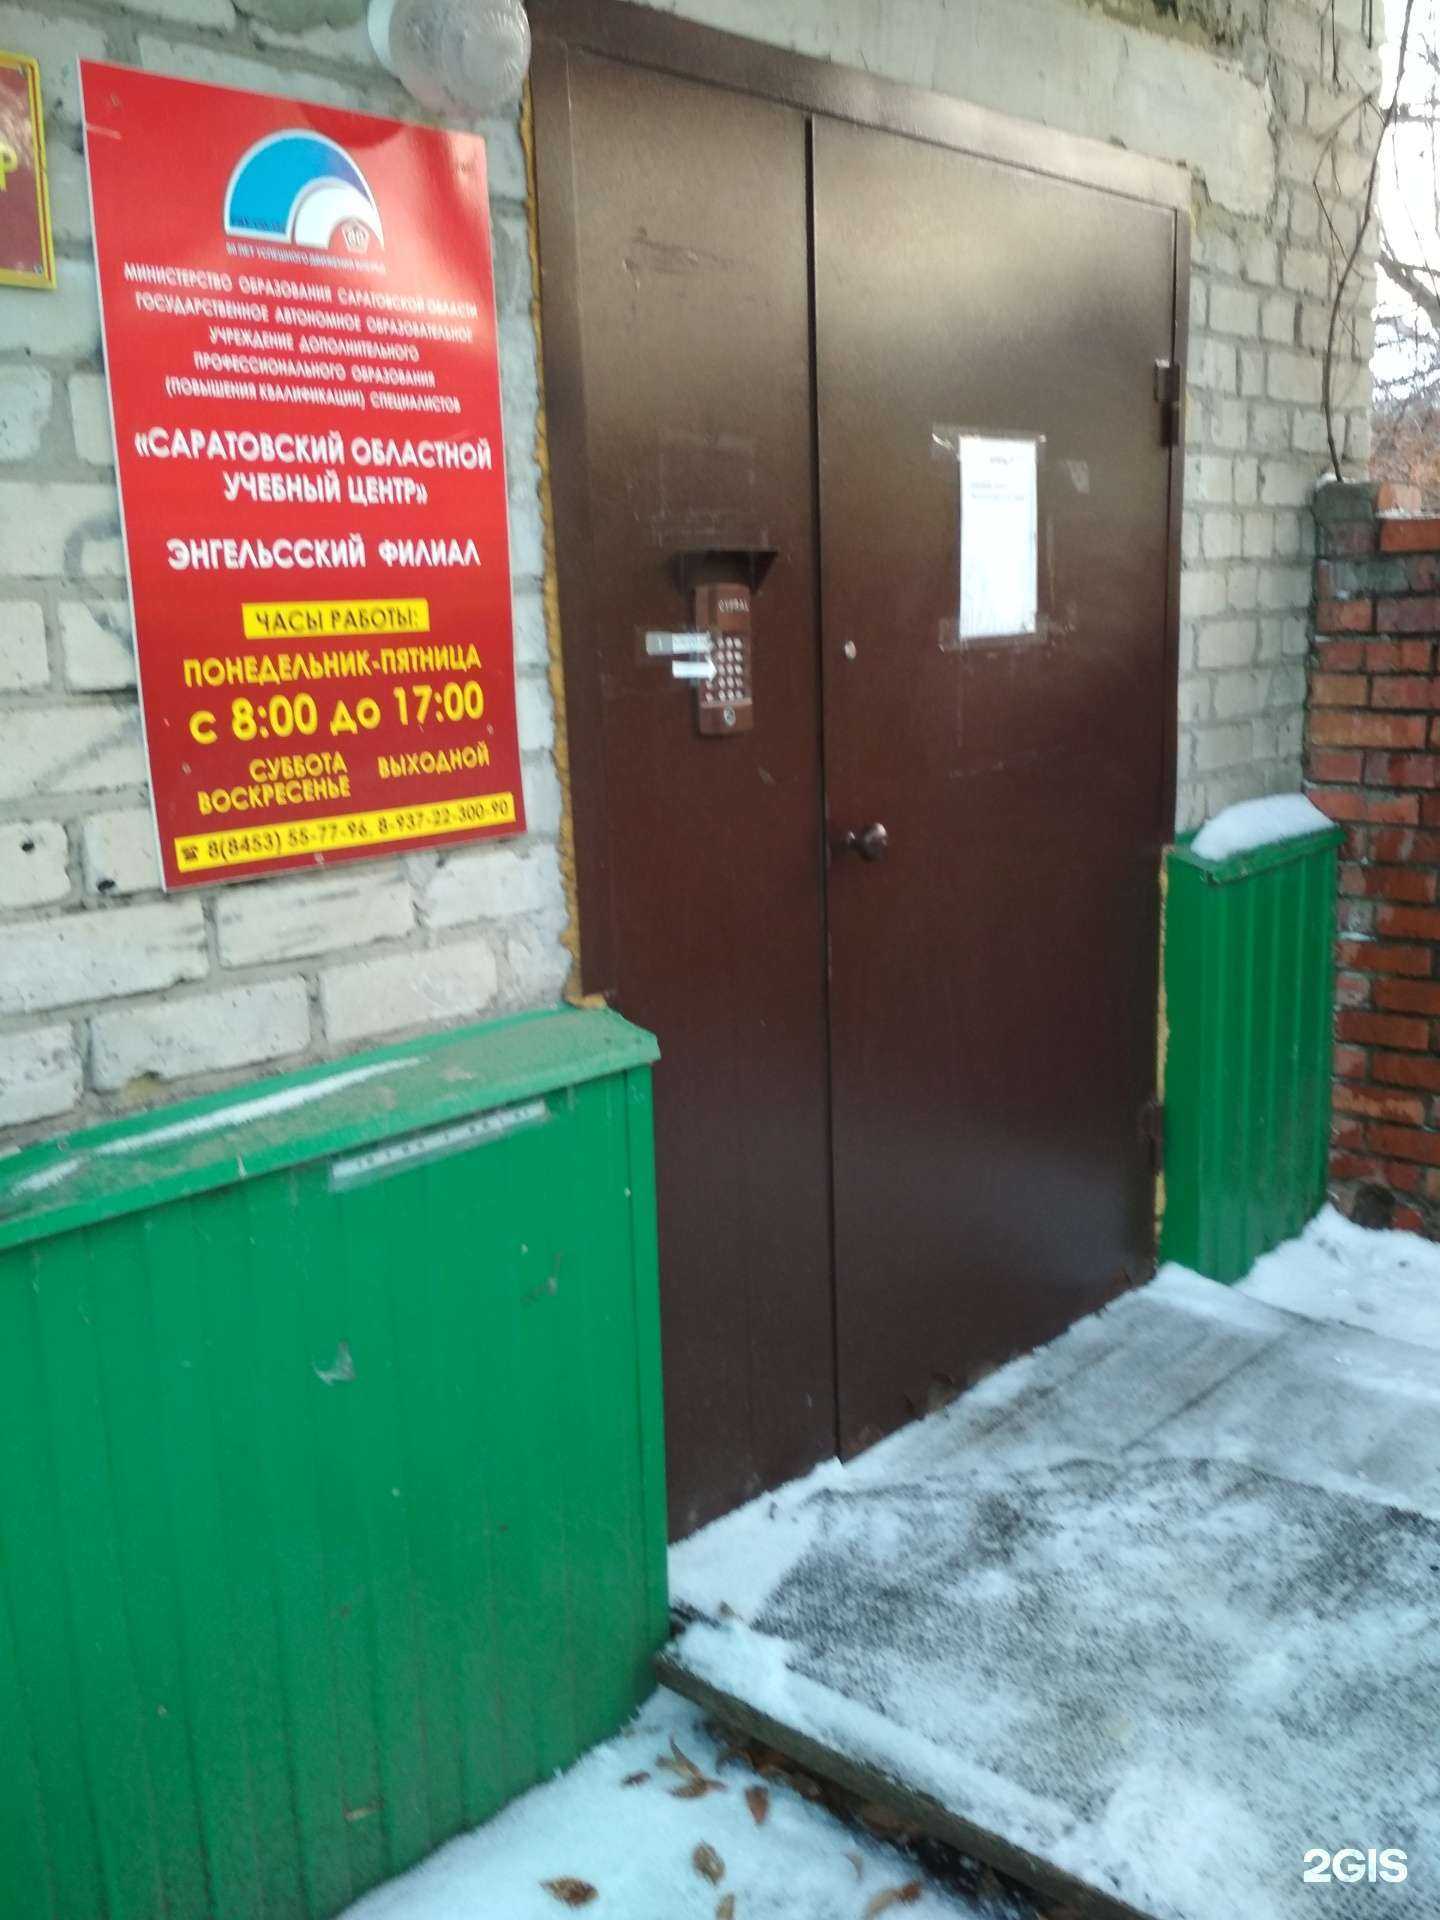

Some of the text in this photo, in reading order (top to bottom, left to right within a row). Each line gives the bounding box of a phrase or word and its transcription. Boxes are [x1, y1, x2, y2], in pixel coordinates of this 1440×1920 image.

[123, 261, 233, 293] МИНИСТЕРСТВО
[238, 274, 333, 304] ОБРАЗОВАНИЯ
[135, 290, 269, 324] ГОСУДАРСТВЕННОЕ
[274, 305, 362, 333] АВТОНОМНОЕ
[209, 325, 420, 363] УЧРЕЖДЕНИЕ ДОПОЛНИТЕЛЬНОГО
[193, 350, 436, 389] ПРОФЕССИОНАЛЬНОГО ОБРАЗОВАНИЯ
[165, 375, 258, 400] (ПОВЫШЕНИЯ
[369, 390, 462, 415] СПЕЦИАЛИСТОВ
[134, 426, 493, 470] «САРАТОВСКИЙ ОБЛАСТНОЙ
[222, 468, 429, 506] УЧЕБНЫЙ ЦЕНТР»
[166, 533, 482, 571] ЭНГЕЛЬССКИЙ ФИЛИАЛ
[256, 610, 324, 634] ЧАСЫ
[183, 643, 482, 687] ПОНЕДЕЛЬНИК-ПЯТНИЦА
[231, 692, 319, 741] 8:00
[393, 679, 485, 726] 17:00
[249, 740, 491, 784] СУББОТА ВЫХОДНОЙ
[197, 775, 352, 816] ВОСКРЕСЕНЬЕ
